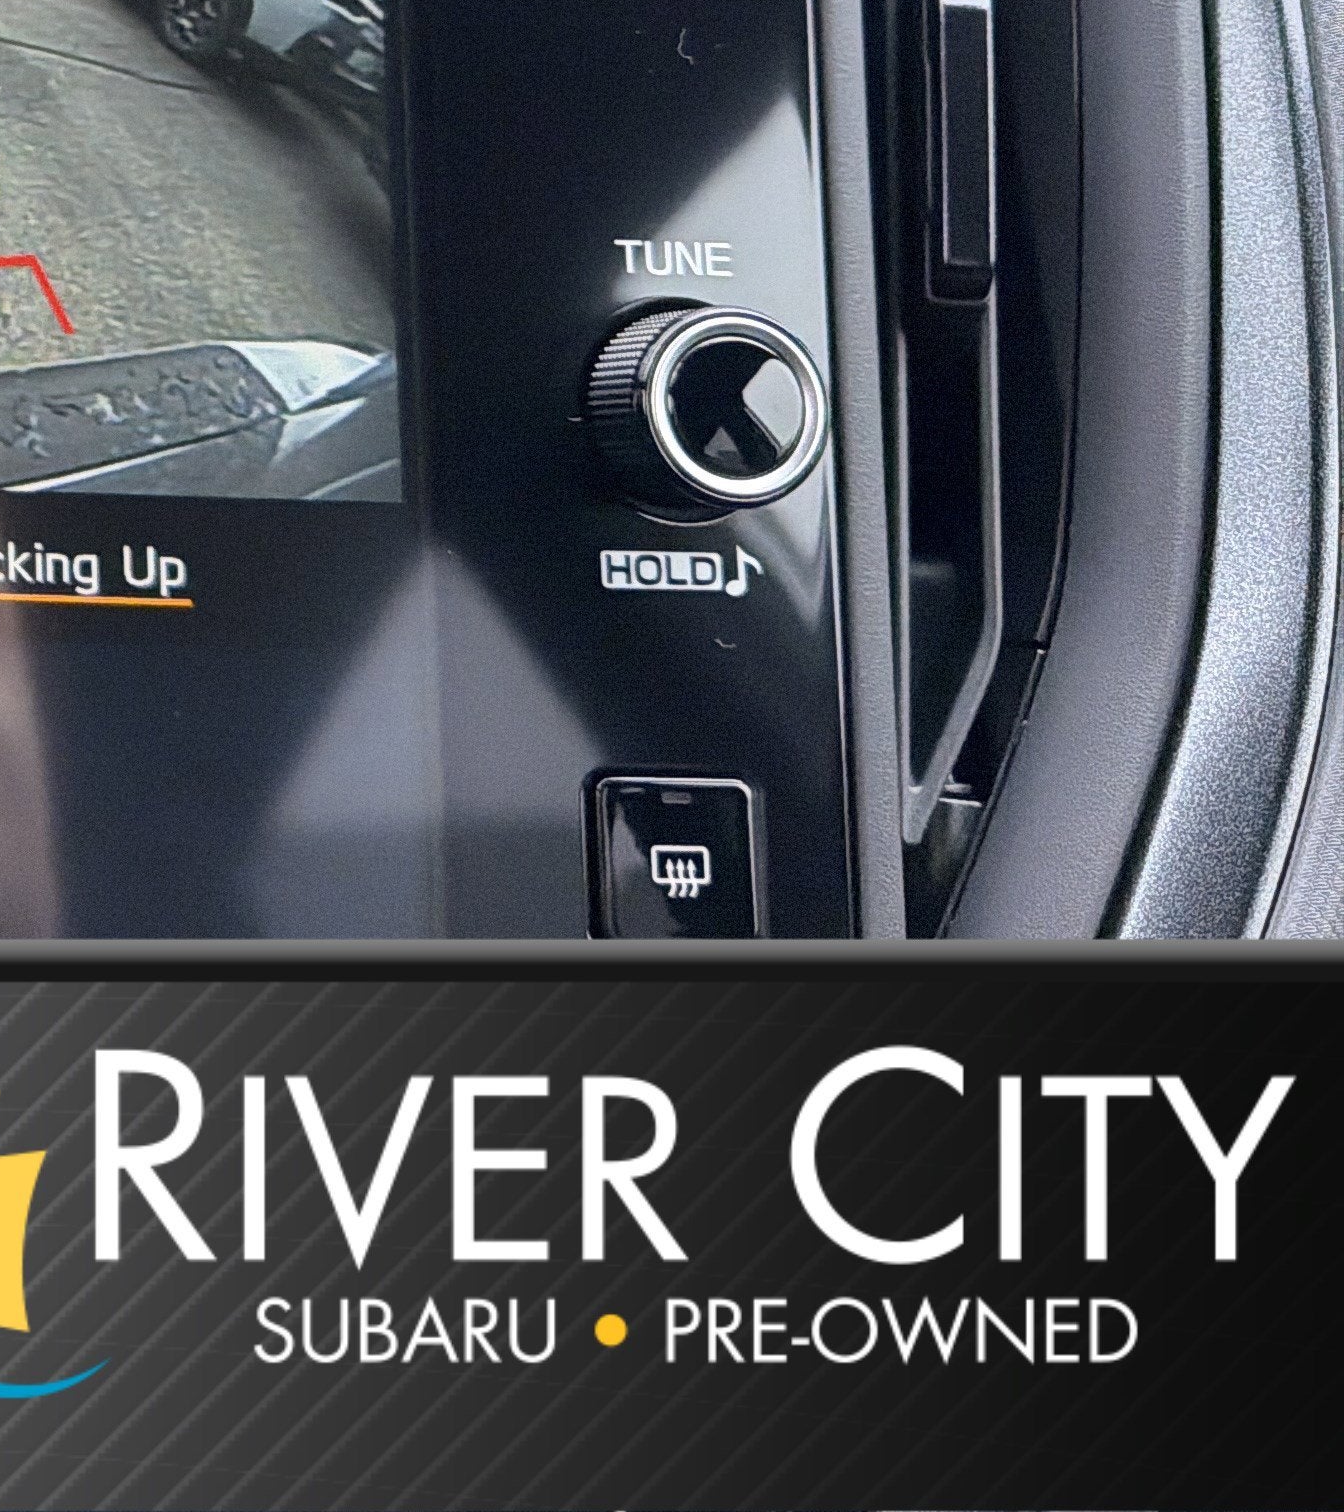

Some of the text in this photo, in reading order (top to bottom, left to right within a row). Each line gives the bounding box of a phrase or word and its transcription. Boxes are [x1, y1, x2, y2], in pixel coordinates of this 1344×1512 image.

[614, 238, 734, 277] TUNE
[121, 545, 187, 594] Up
[604, 552, 717, 587] HOLD
